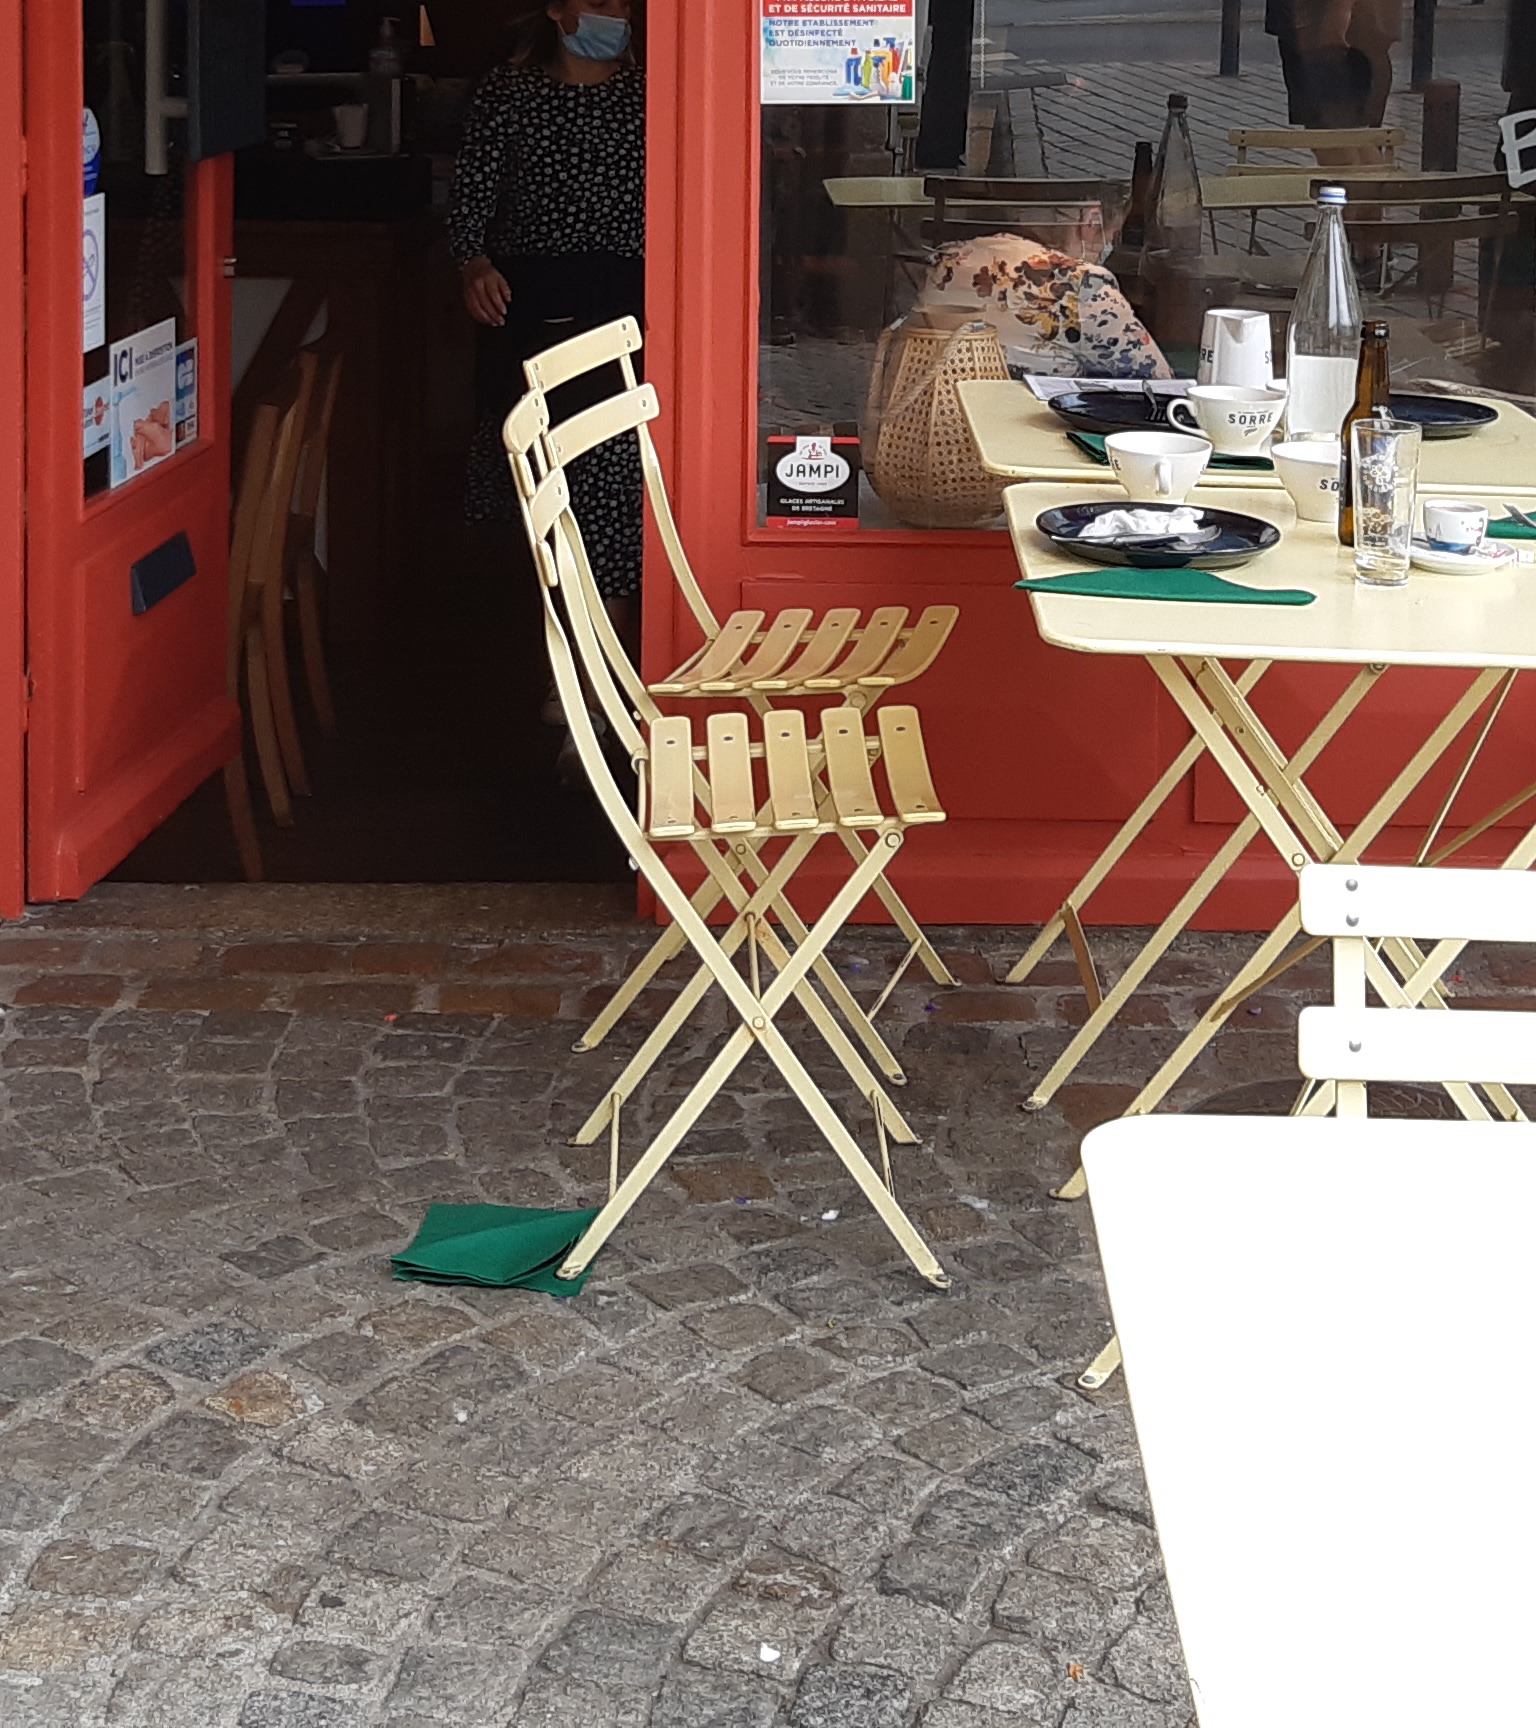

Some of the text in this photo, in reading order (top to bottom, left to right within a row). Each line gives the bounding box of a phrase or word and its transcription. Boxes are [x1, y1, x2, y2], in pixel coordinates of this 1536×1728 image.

[768, 2, 907, 13] ET DE SÉCURITÉ SANITAIRE
[768, 19, 800, 27] NOTRE
[768, 27, 843, 37] EST DÉSINFECTÉ
[768, 39, 856, 47] QUOTIDIENNEMENT
[113, 346, 134, 387] ICI
[1228, 412, 1274, 425] SORRE
[785, 463, 840, 479] JAMPI
